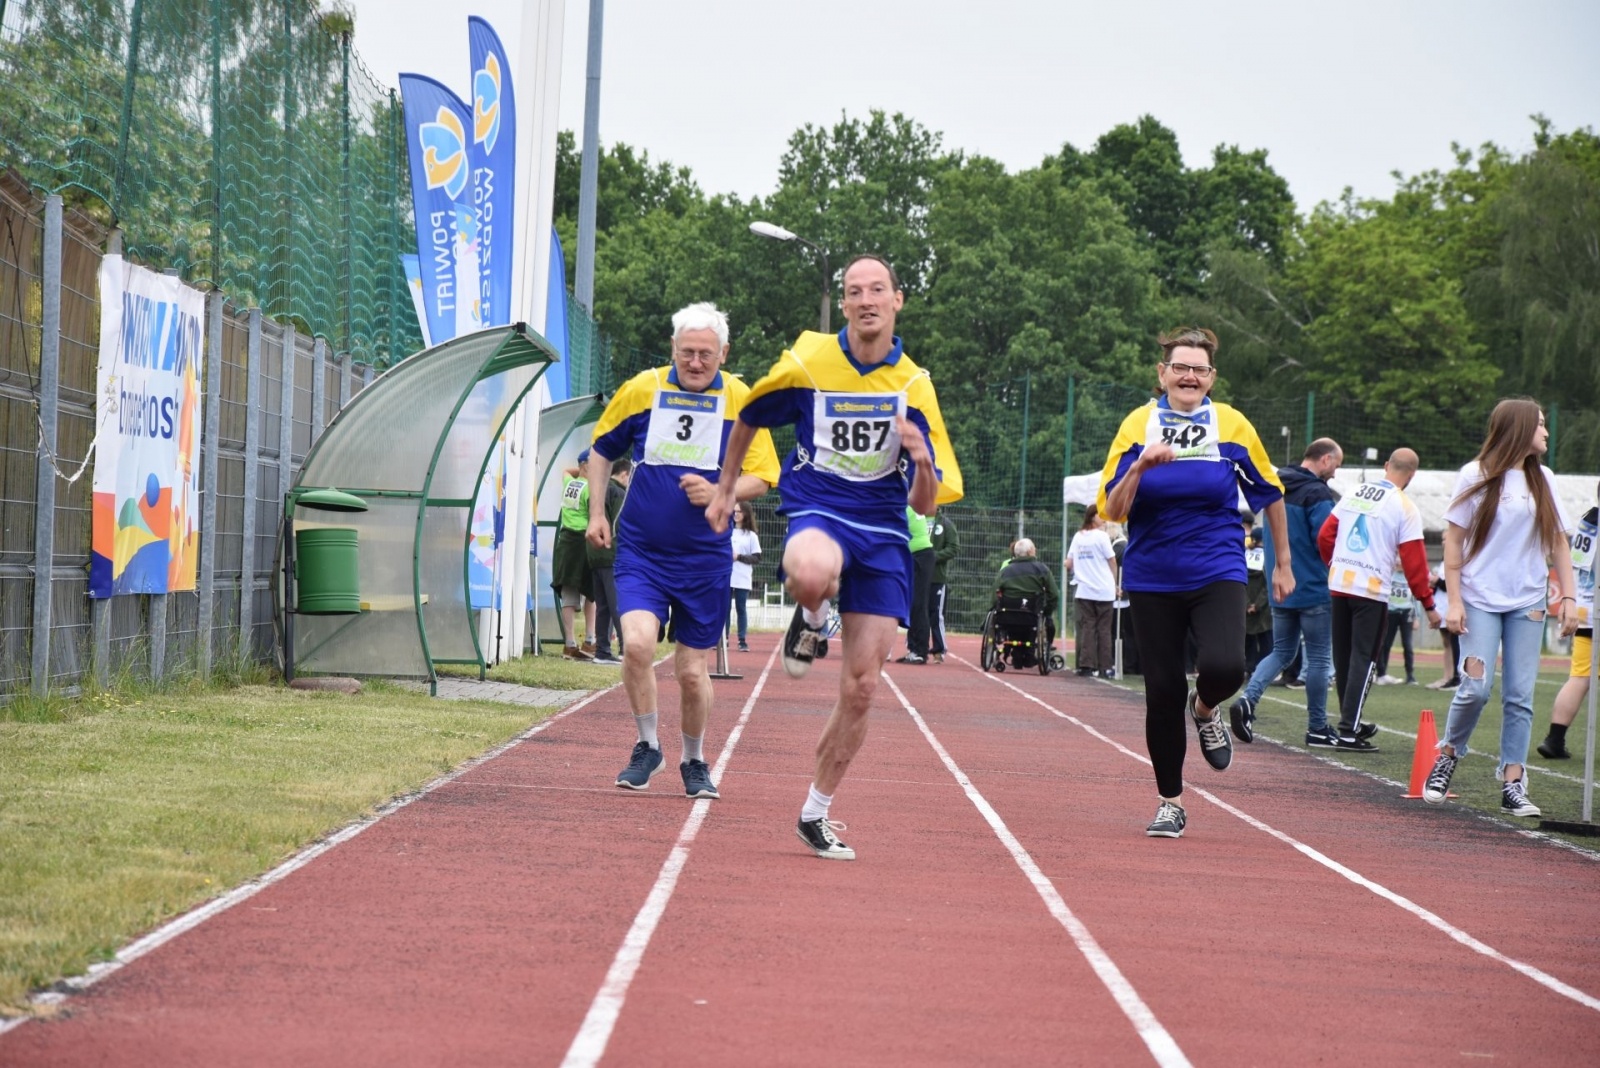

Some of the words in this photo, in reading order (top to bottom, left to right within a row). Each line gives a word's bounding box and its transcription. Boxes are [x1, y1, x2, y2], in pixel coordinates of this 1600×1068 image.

[676, 414, 694, 442] 3
[831, 420, 891, 452] 867
[1161, 425, 1207, 449] 842
[1355, 484, 1386, 502] 380
[1246, 552, 1261, 562] 76
